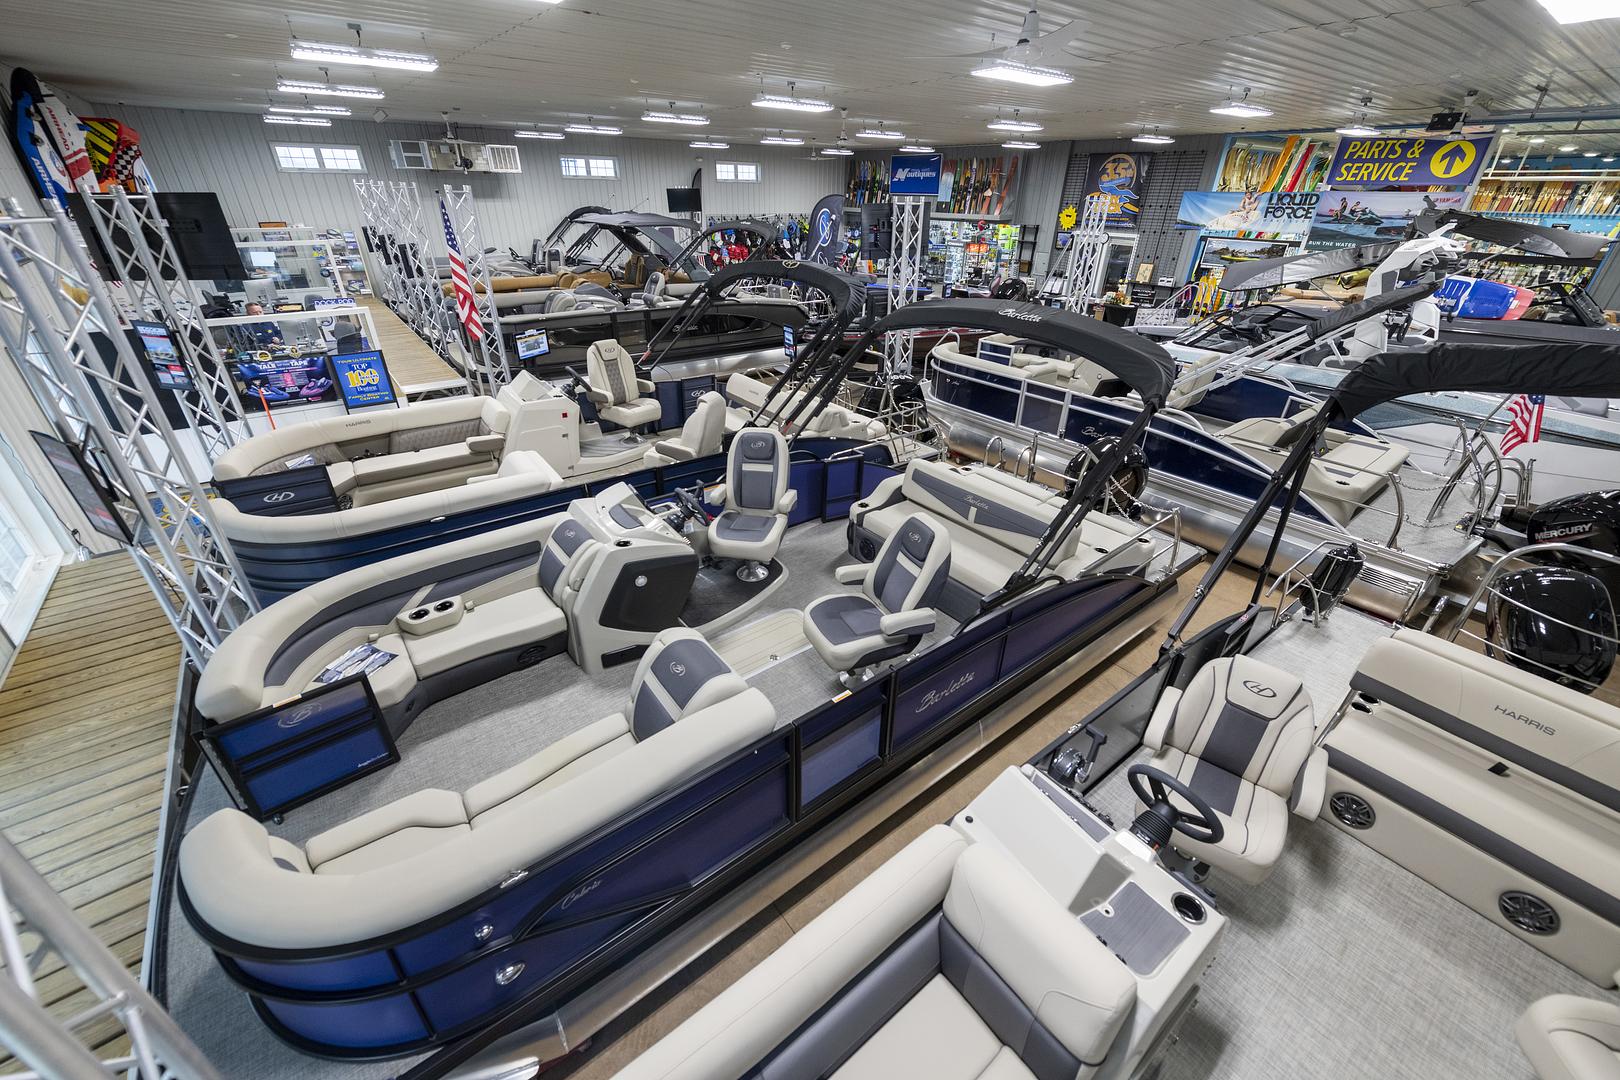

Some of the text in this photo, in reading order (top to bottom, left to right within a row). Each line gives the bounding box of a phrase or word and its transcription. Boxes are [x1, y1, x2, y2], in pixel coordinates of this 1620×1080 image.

[46, 106, 70, 151] AIRHEAD
[1344, 139, 1425, 159] PARTS &
[1335, 162, 1417, 181] SERVICE
[1267, 192, 1321, 206] LIQUID
[1263, 206, 1316, 219] FORCE
[998, 308, 1042, 322] Barletta
[345, 368, 380, 388] 100
[1534, 522, 1593, 541] MERCURY
[915, 671, 976, 713] Barletta
[1494, 704, 1557, 736] HARRIS
